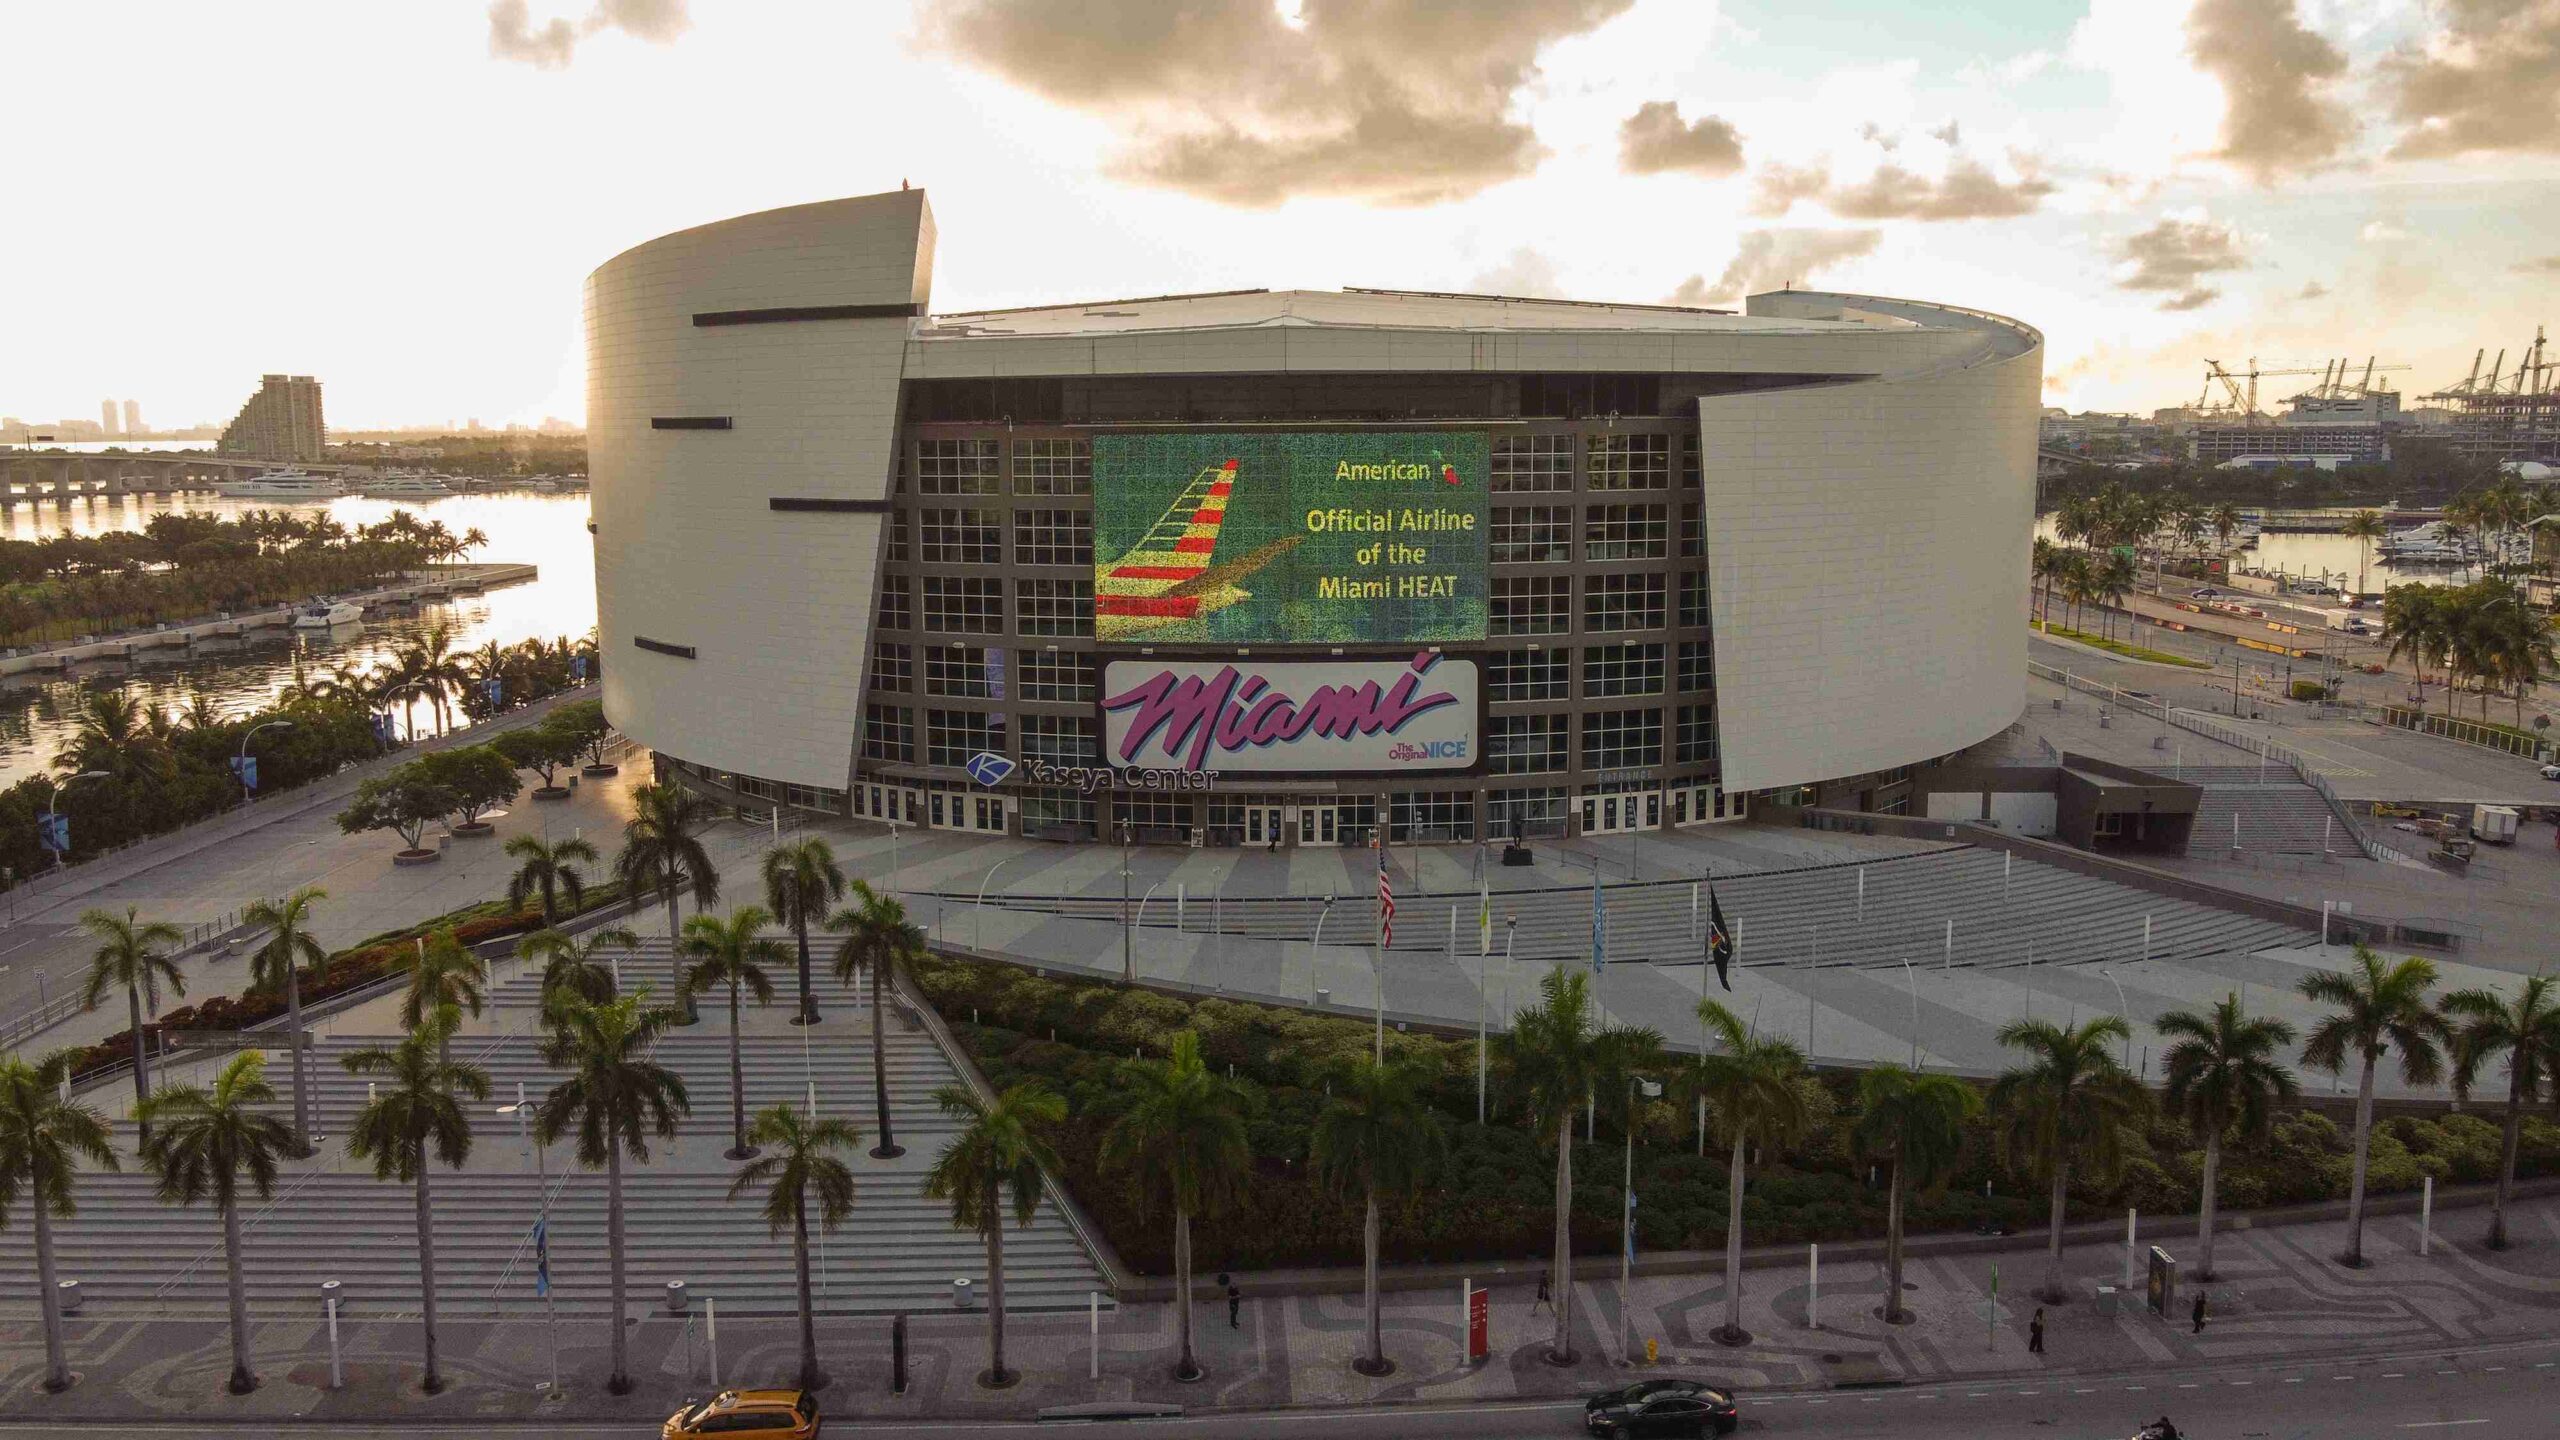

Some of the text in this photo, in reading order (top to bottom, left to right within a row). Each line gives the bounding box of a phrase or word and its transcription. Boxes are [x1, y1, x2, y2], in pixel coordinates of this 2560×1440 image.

[1335, 459, 1431, 481] American
[1306, 508, 1475, 532] Official Airline
[1356, 542, 1426, 565] of the
[1318, 575, 1458, 599] Miami HEAT
[1101, 651, 1461, 771] Miami
[1389, 749, 1428, 761] Original
[1396, 743, 1413, 752] The
[1023, 759, 1219, 794] Kaseya Center
